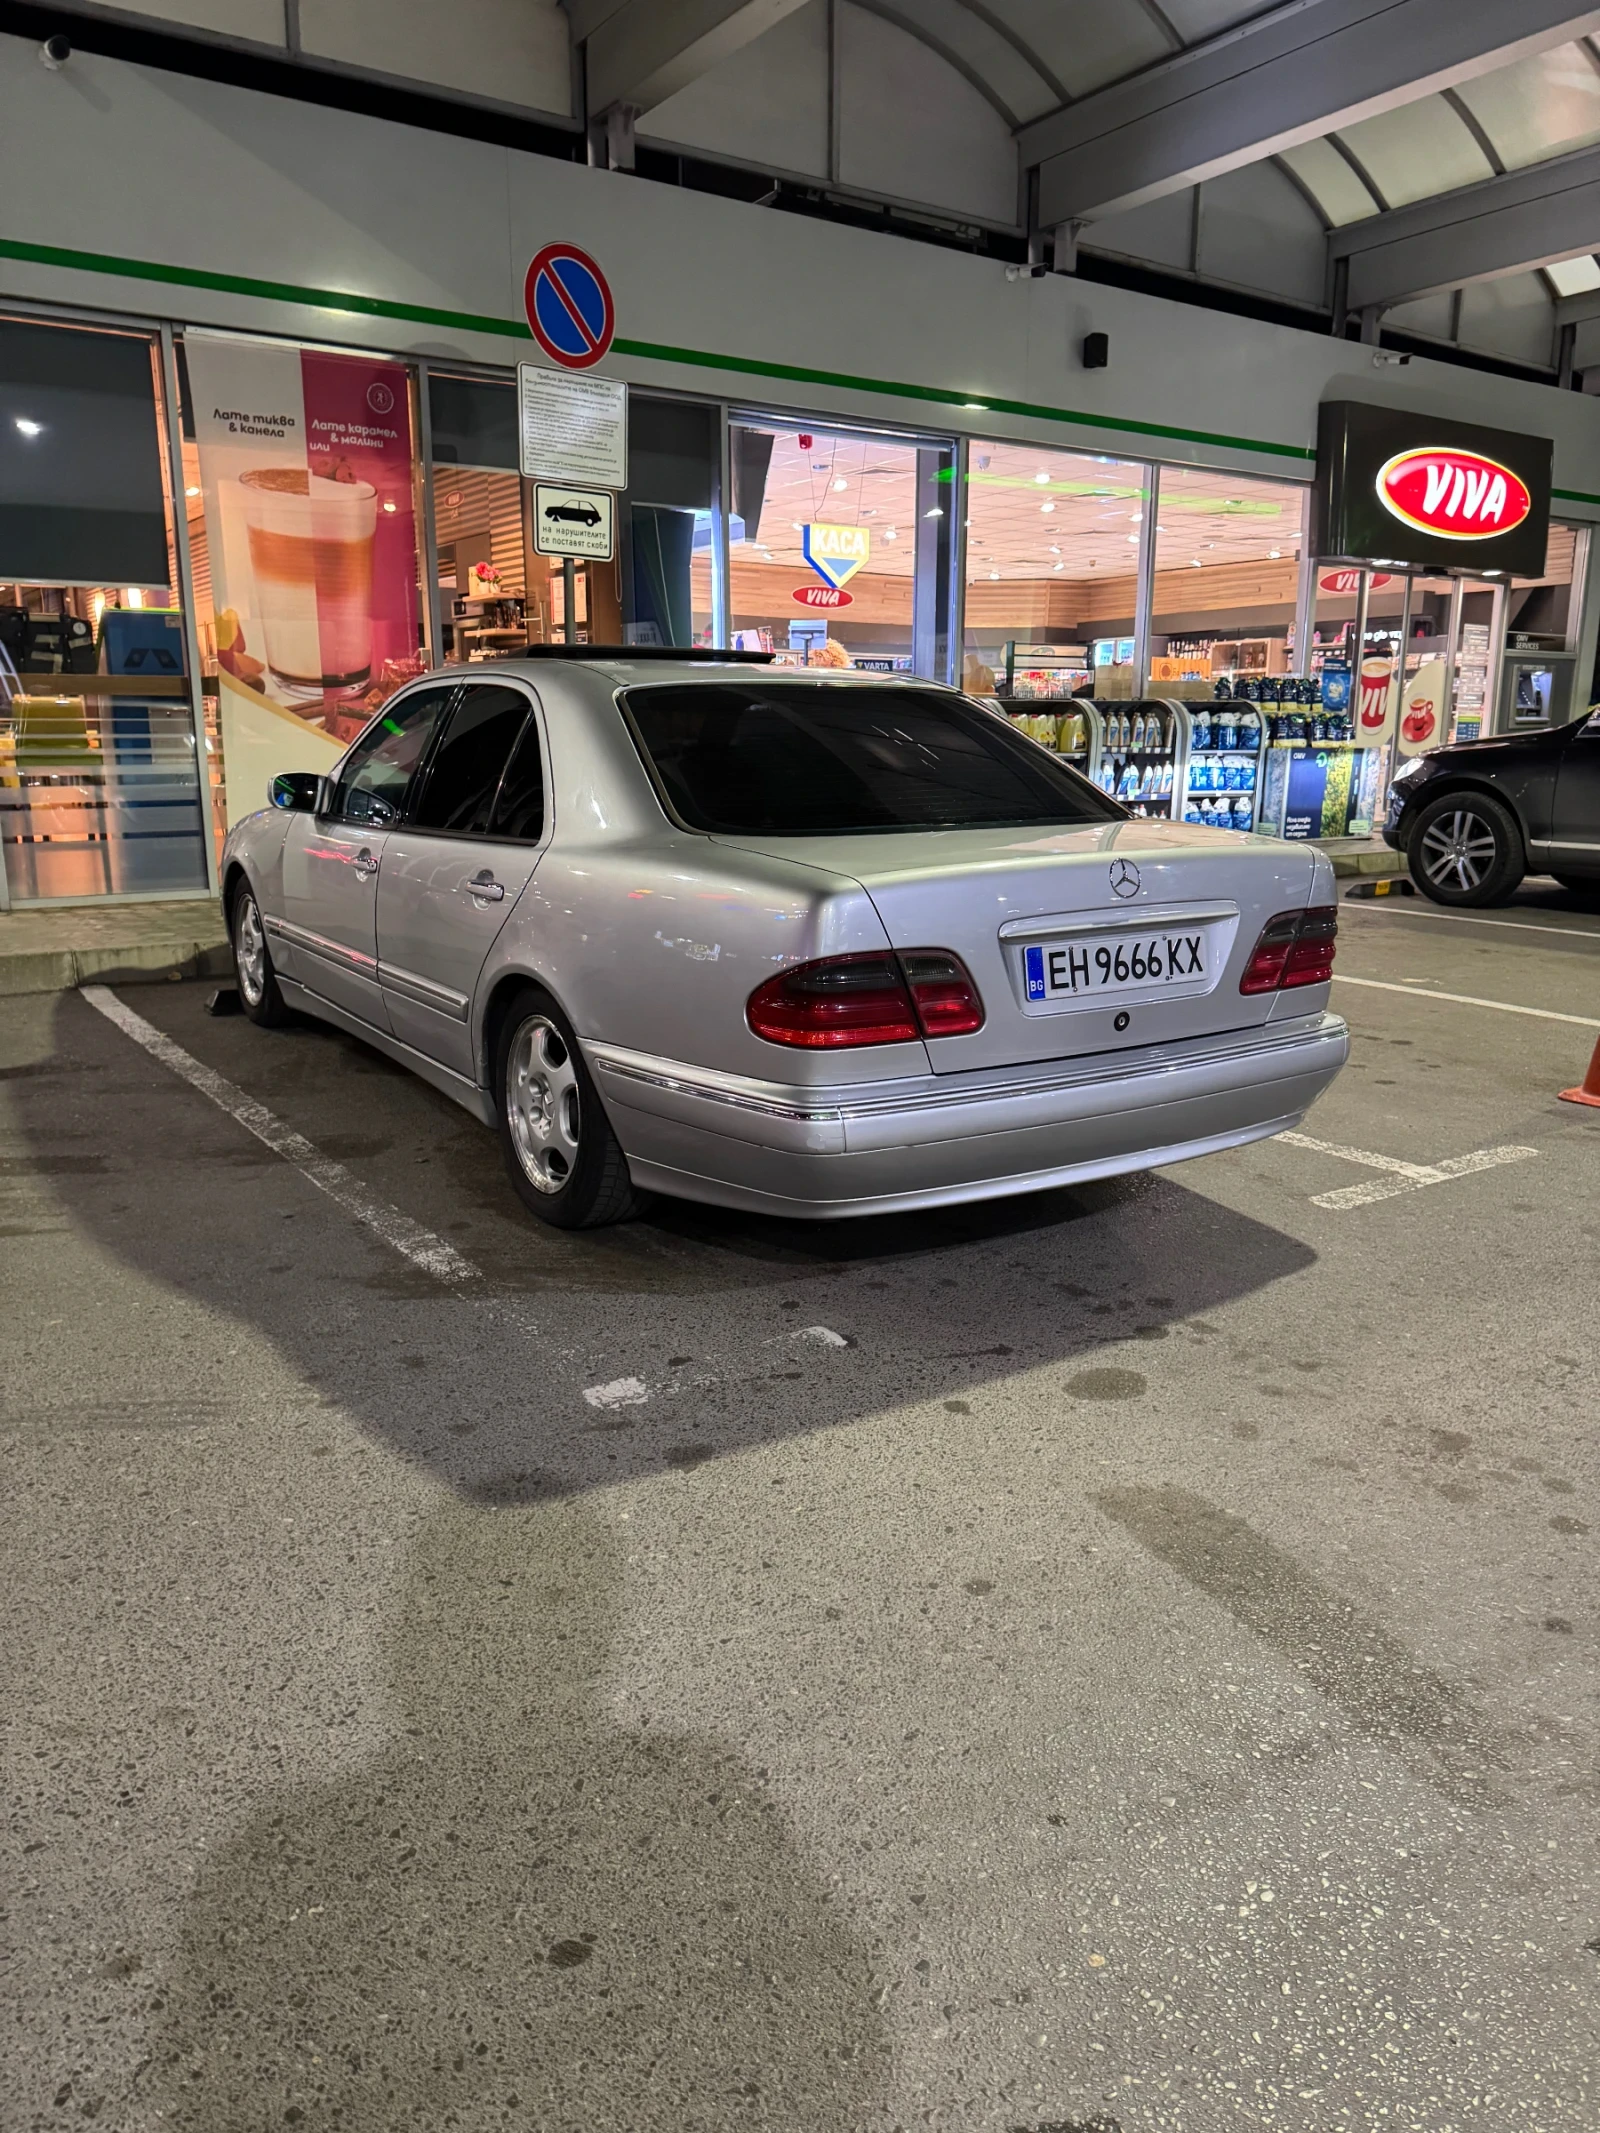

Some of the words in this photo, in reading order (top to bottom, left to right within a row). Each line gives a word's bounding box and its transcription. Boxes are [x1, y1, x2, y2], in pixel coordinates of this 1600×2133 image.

[213, 408, 250, 422] Лате
[253, 414, 295, 427] тиква
[228, 422, 238, 432] &
[240, 422, 285, 438] канела
[311, 419, 346, 432] Лате
[348, 423, 398, 438] карамел
[309, 442, 330, 452] или
[330, 433, 339, 443] &
[341, 437, 384, 448] малини
[1422, 462, 1507, 525] VIVA
[556, 528, 606, 539] нарушителите
[552, 537, 585, 547] поставят
[586, 541, 608, 550] скоби
[814, 528, 866, 556] КАСА
[806, 588, 841, 606] VIVA
[1515, 641, 1540, 650] SERVICES
[864, 661, 890, 671] VARTA
[1293, 752, 1306, 760] OMV
[1030, 979, 1044, 992] BG
